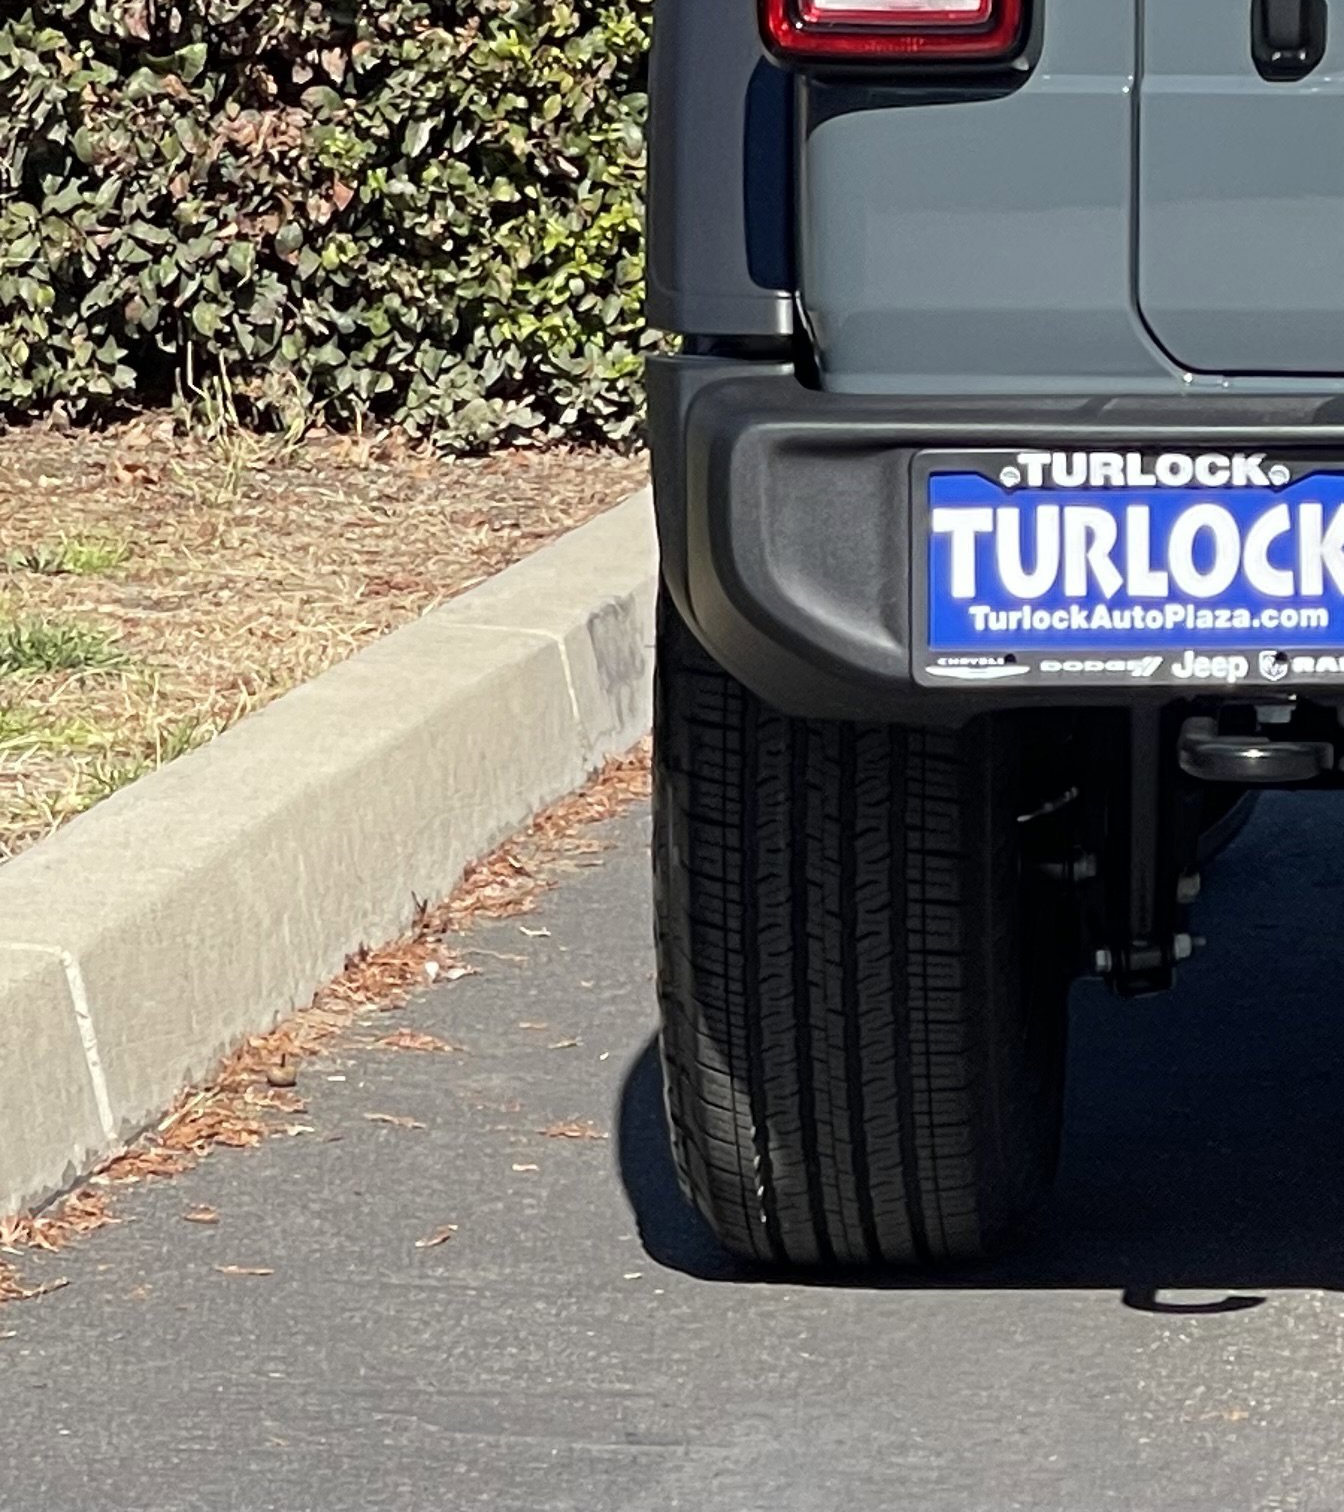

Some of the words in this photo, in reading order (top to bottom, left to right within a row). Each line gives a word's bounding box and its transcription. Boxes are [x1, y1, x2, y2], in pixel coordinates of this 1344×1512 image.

[1017, 452, 1268, 486] TURLOCK
[968, 604, 1329, 631] TurlockAutoPlaza.com
[1171, 650, 1249, 683] Jeep
